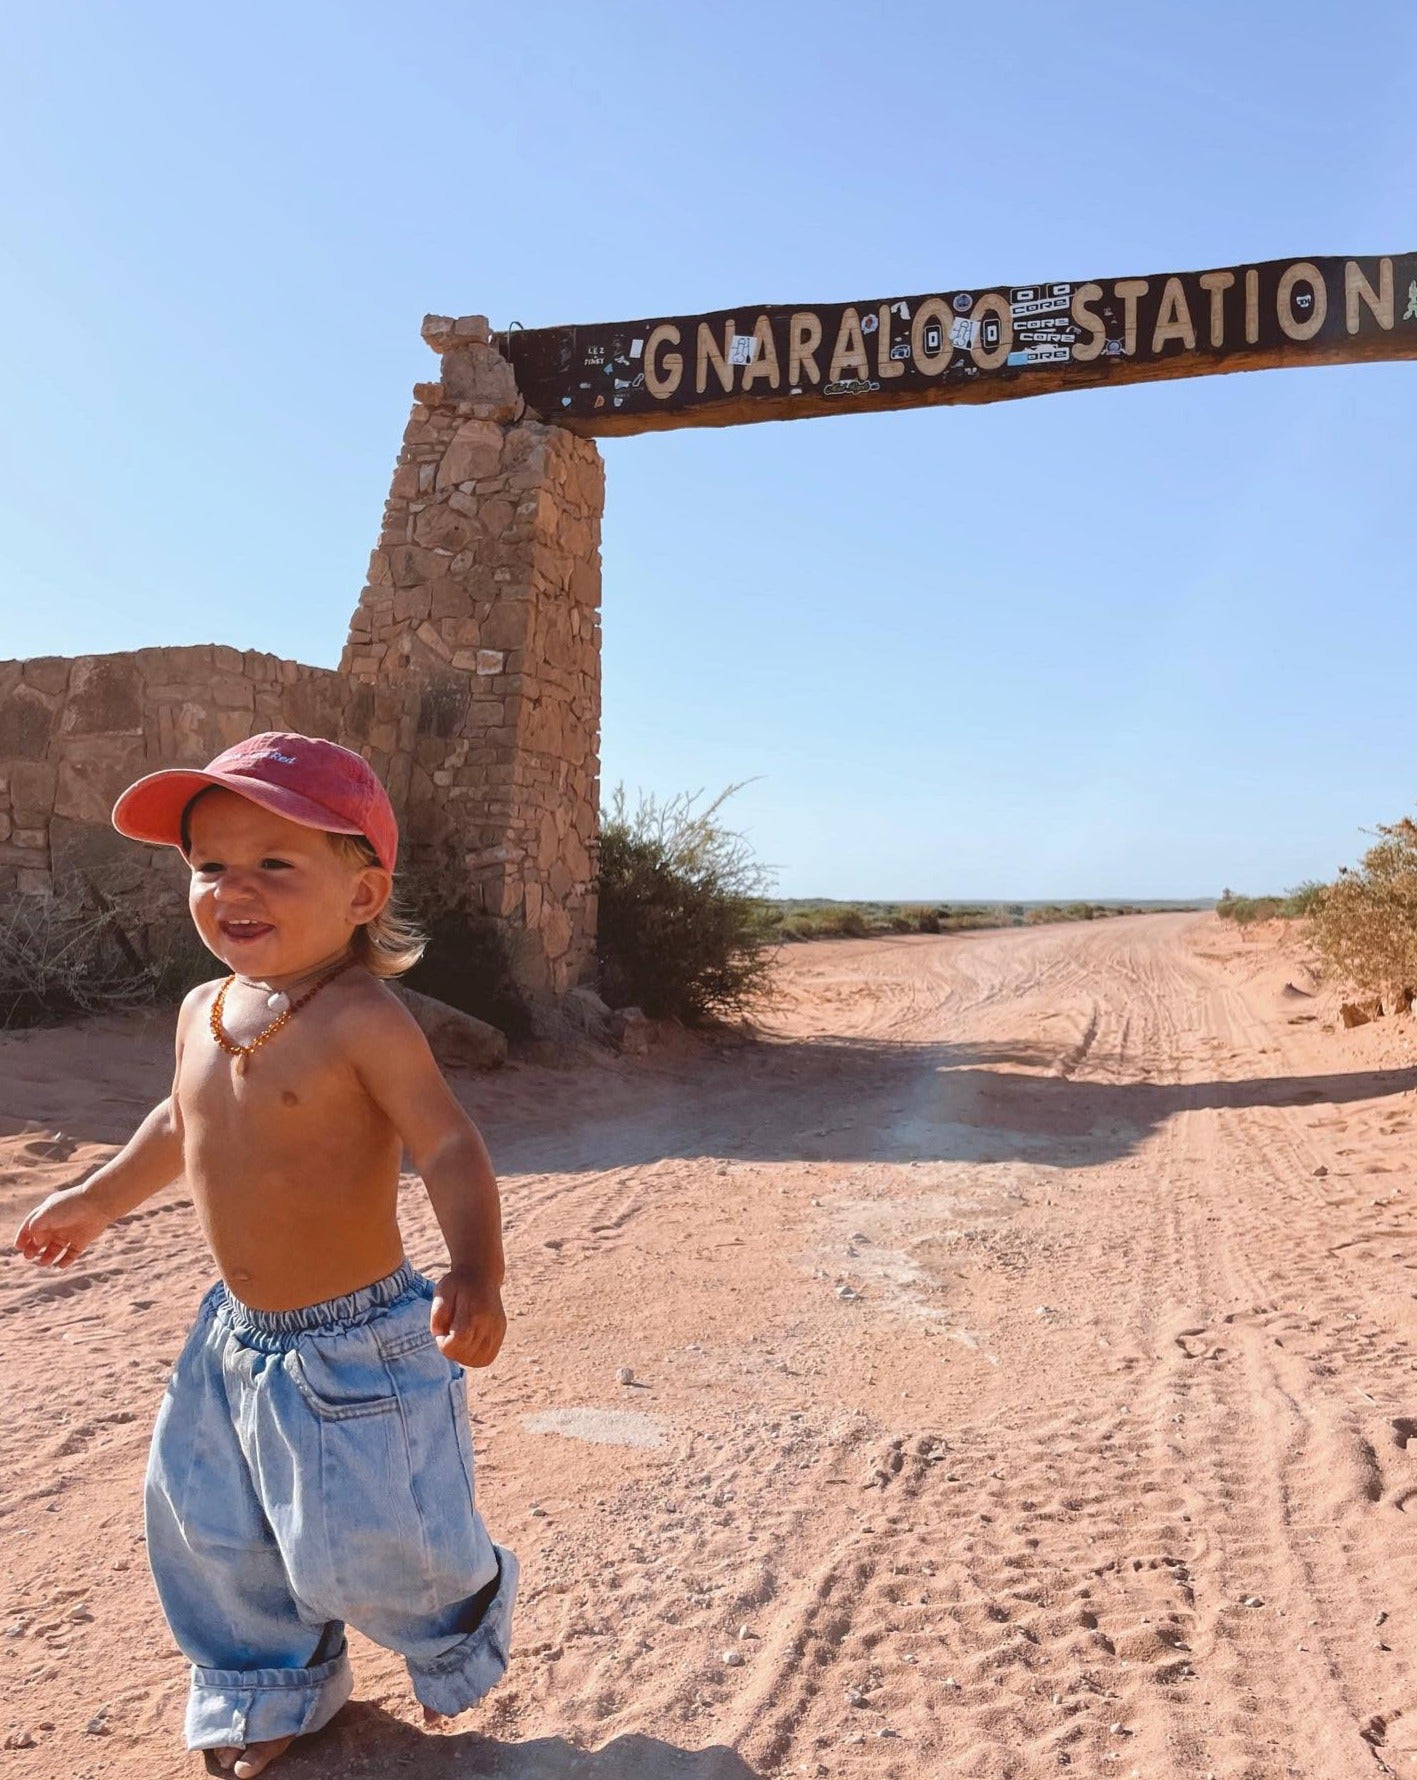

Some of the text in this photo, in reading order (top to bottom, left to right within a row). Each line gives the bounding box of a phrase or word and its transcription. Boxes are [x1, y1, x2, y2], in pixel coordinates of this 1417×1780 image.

[1012, 298, 1067, 315] CORE
[643, 257, 1394, 399] GNARALOO STATION
[1013, 317, 1069, 330] CORE
[1019, 333, 1075, 343] CORE
[1027, 350, 1067, 361] ORE
